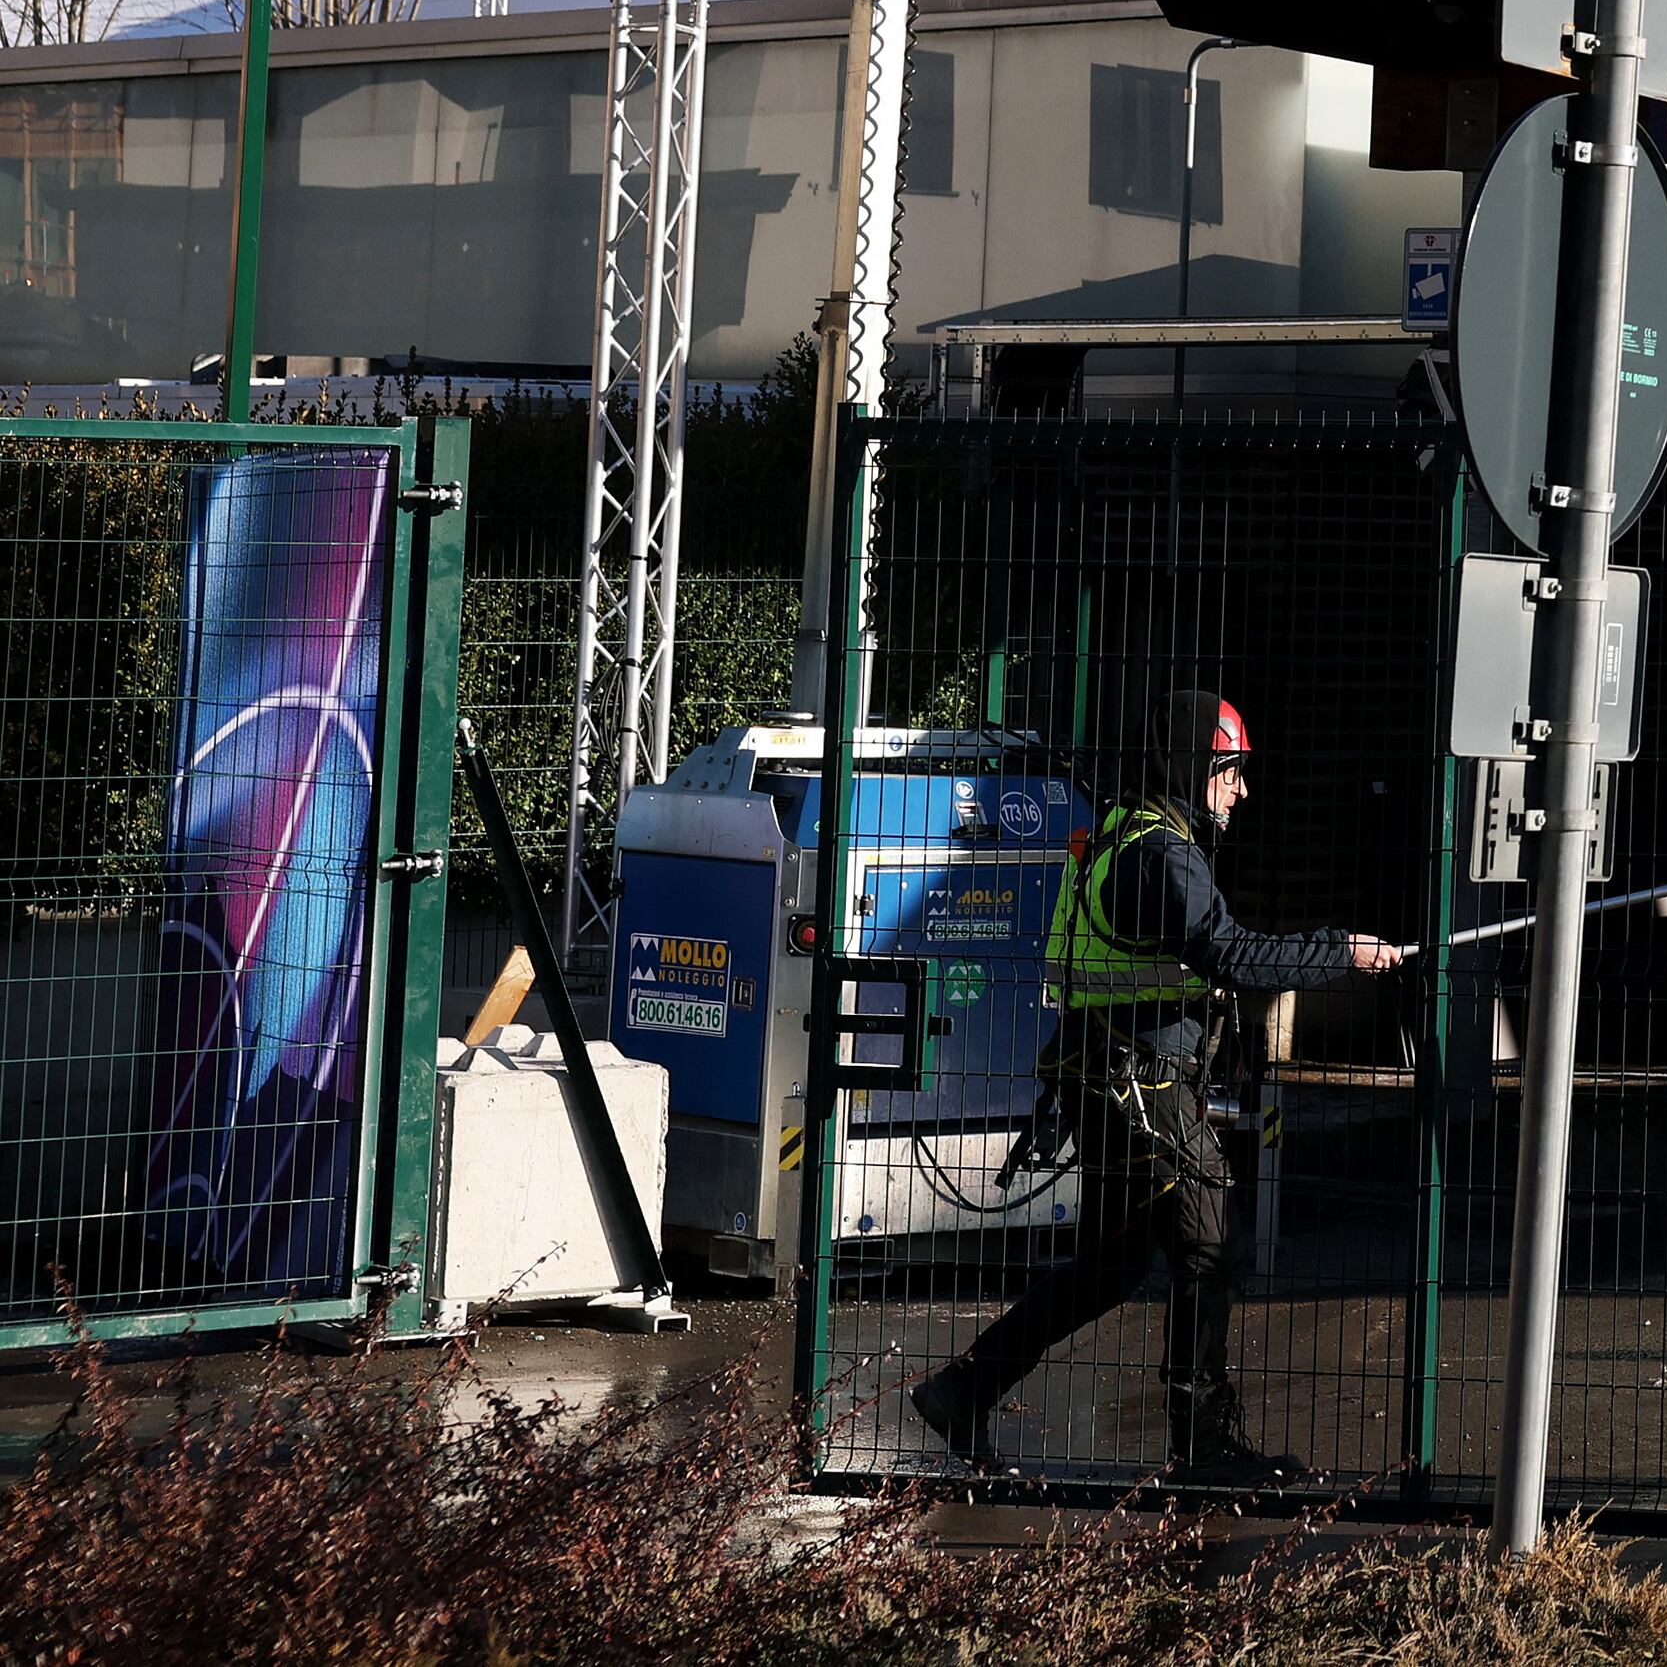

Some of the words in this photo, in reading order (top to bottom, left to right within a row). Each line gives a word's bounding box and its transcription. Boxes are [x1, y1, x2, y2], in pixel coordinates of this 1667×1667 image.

[1633, 373, 1658, 386] BORMIO
[660, 939, 727, 968] MOLLO
[658, 969, 725, 987] NOLEGGIO
[638, 1000, 721, 1029] 800.61.46.16
